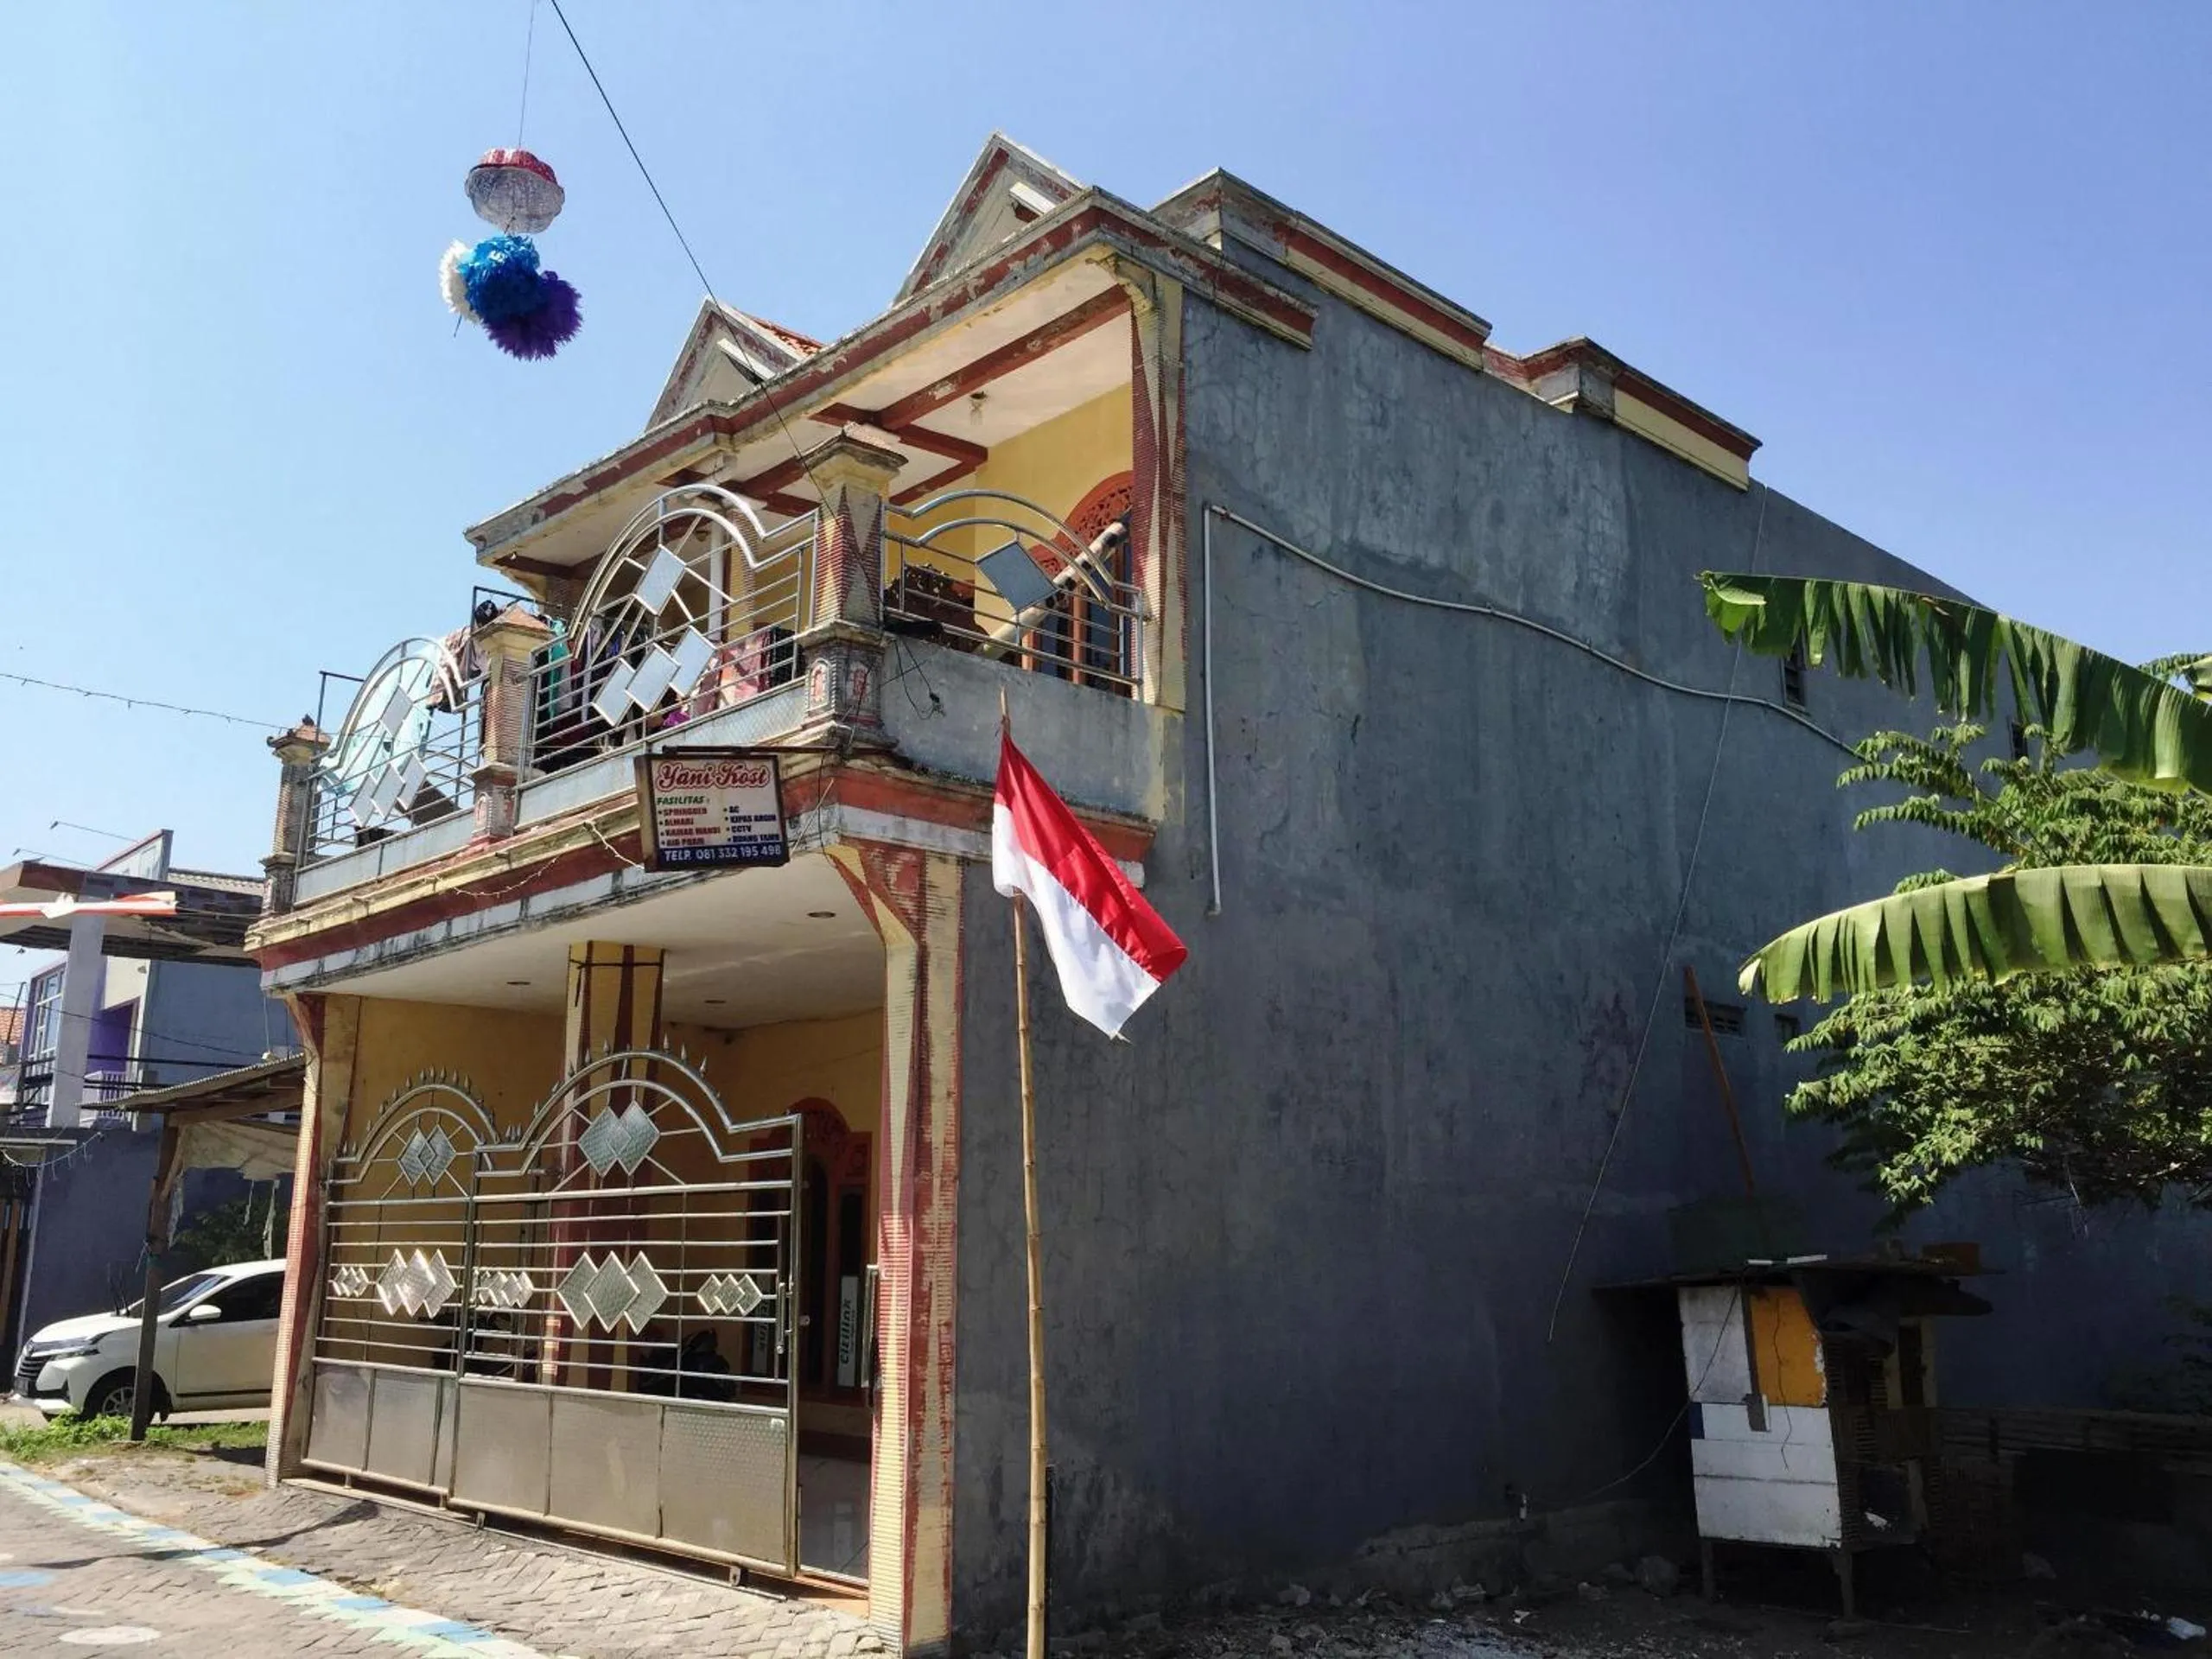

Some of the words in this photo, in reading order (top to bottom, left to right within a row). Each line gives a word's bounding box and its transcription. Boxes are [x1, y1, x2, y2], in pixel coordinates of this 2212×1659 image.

[658, 762, 714, 791] Yani
[715, 761, 769, 787] Kost
[657, 796, 705, 805] FASILITAS
[696, 848, 715, 861] 081
[718, 847, 738, 858] 332
[760, 844, 781, 855] 498
